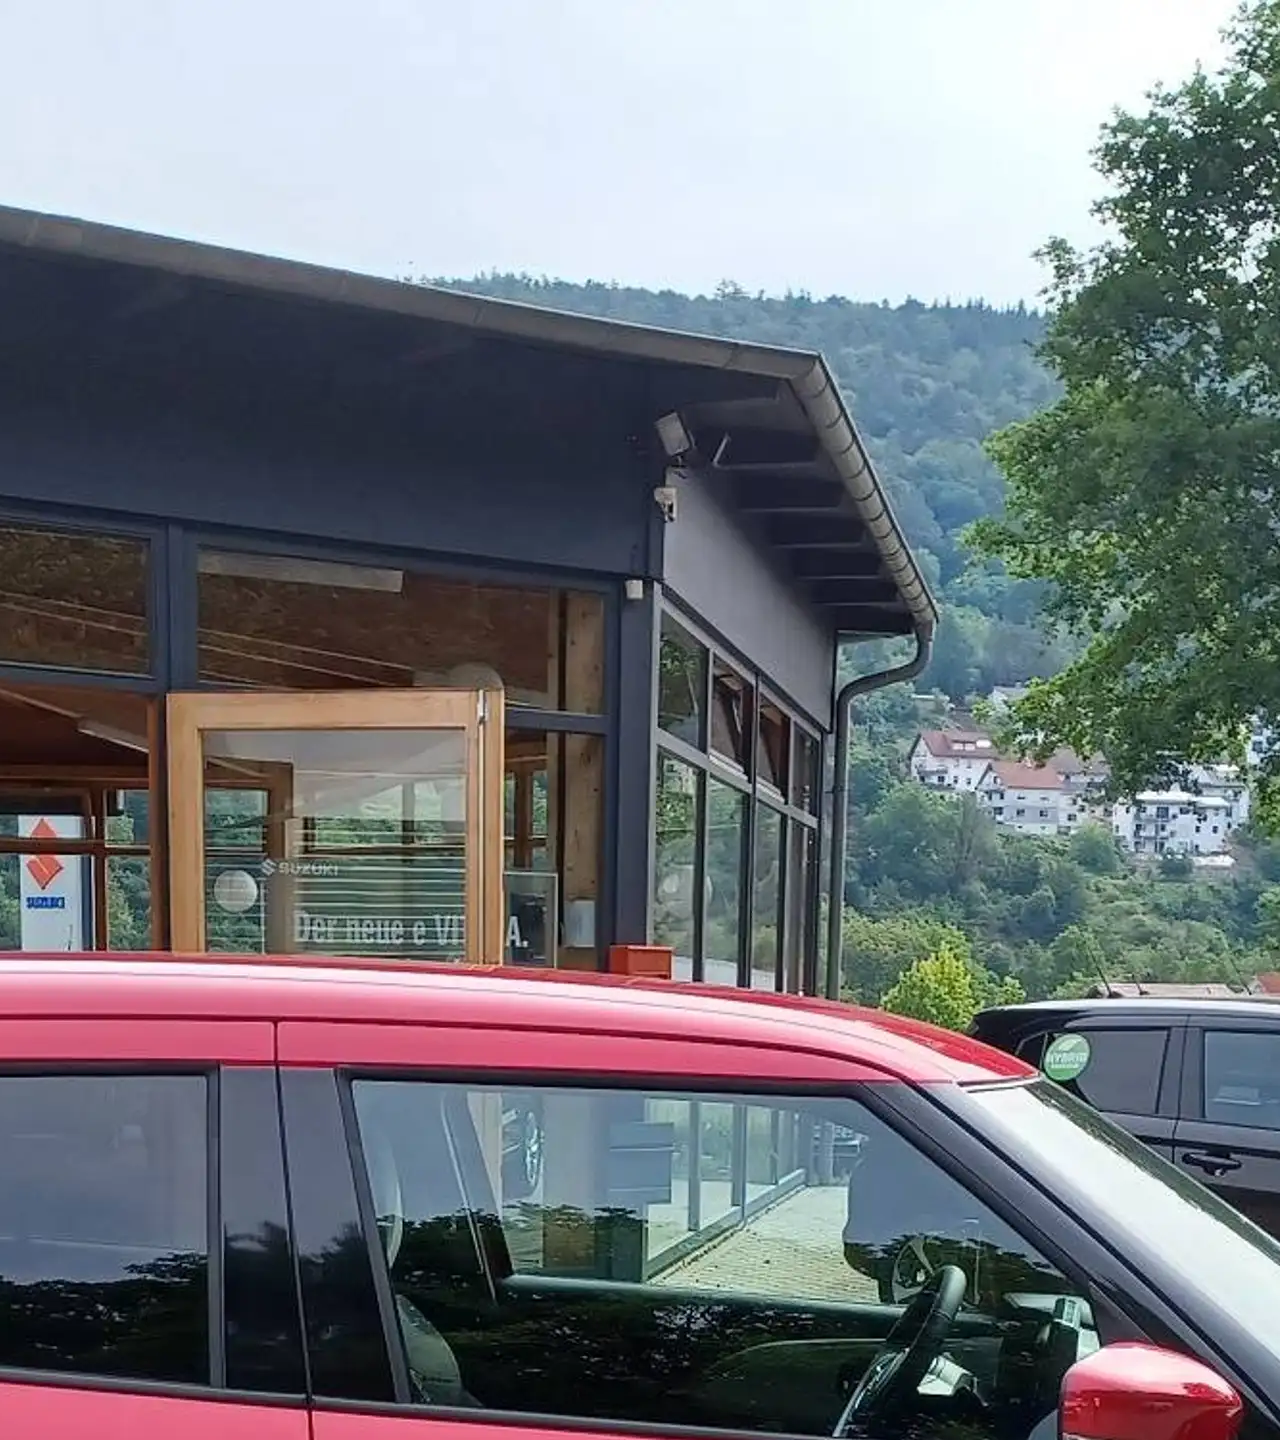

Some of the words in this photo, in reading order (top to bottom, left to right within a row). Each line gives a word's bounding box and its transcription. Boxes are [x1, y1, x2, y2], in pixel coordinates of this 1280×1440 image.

[278, 862, 339, 876] SUZUKI
[296, 912, 337, 942] Der
[346, 918, 404, 944] neue
[413, 920, 426, 945] e
